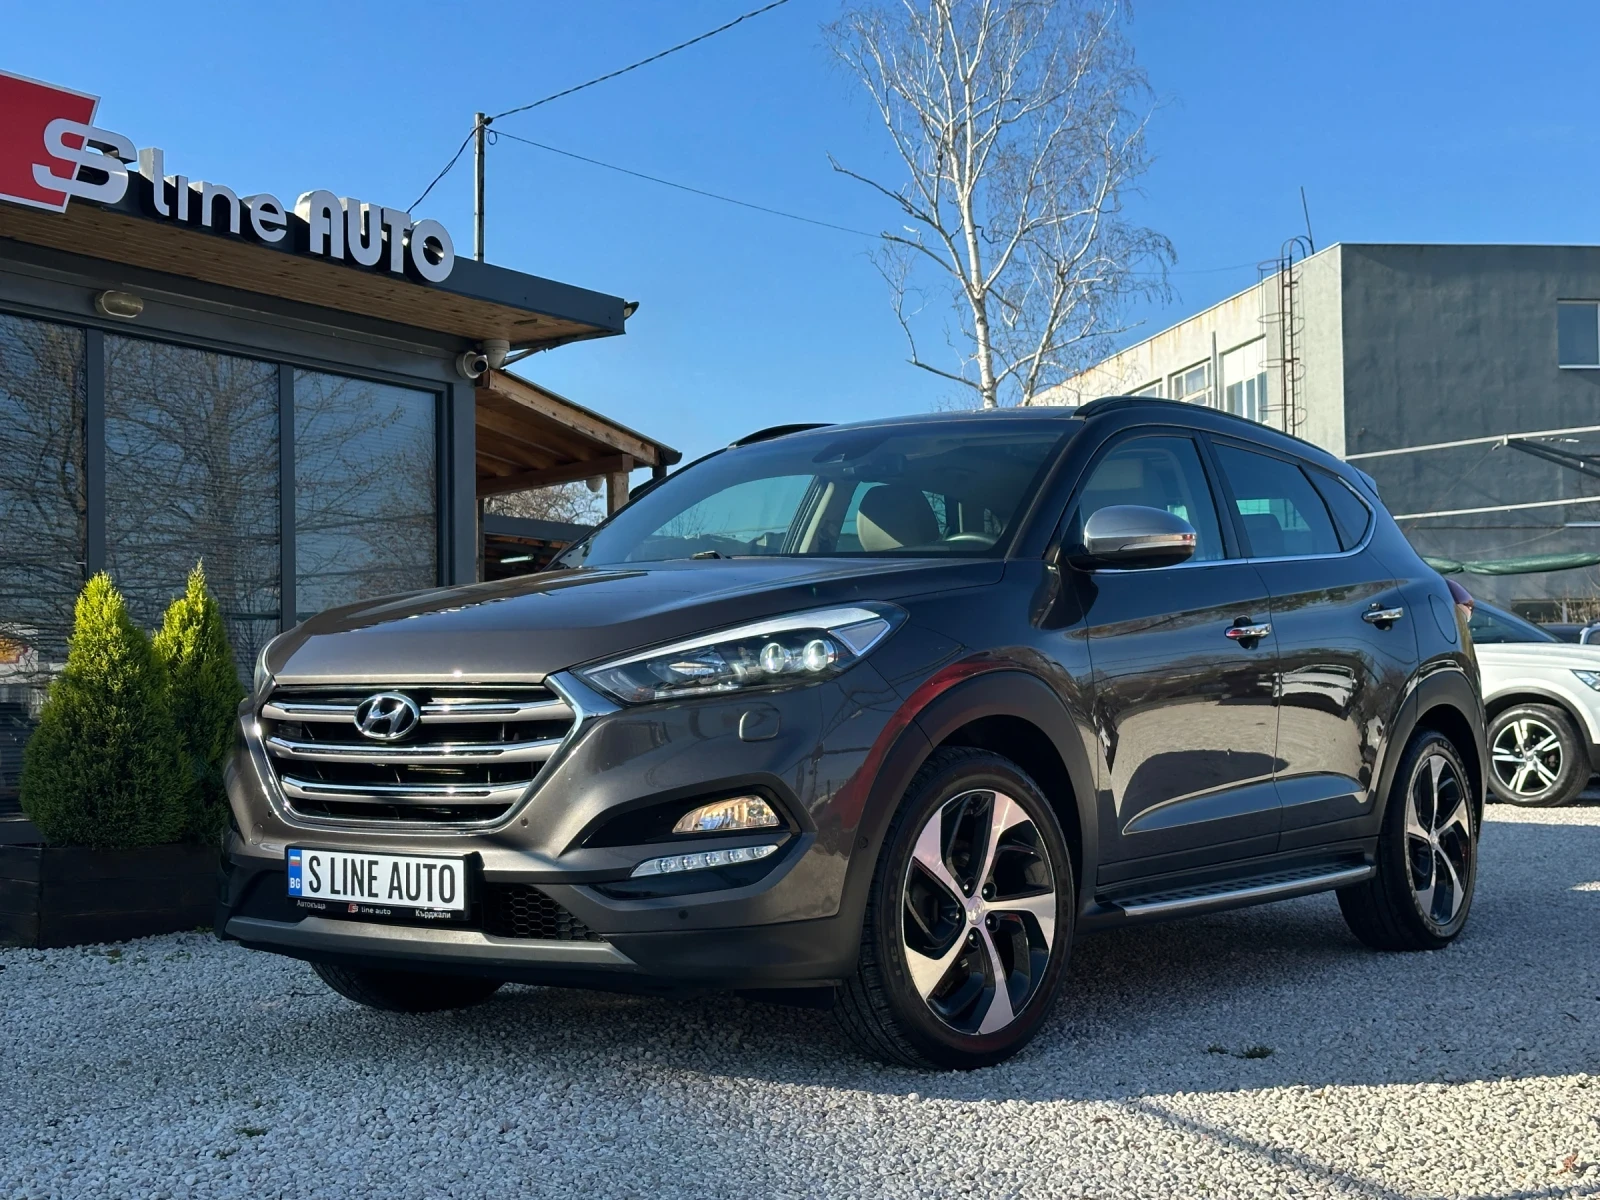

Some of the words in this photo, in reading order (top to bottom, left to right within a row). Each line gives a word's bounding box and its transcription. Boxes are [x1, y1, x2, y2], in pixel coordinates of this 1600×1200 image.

[31, 117, 137, 205] S
[139, 147, 288, 243] line
[296, 189, 455, 283] AUTO
[289, 877, 301, 889] BG
[308, 855, 322, 894] S
[330, 857, 379, 898] LINE
[387, 861, 456, 904] AUTO
[296, 899, 327, 910] Автокъща
[361, 907, 374, 915] line
[415, 908, 451, 920] Кърджали
